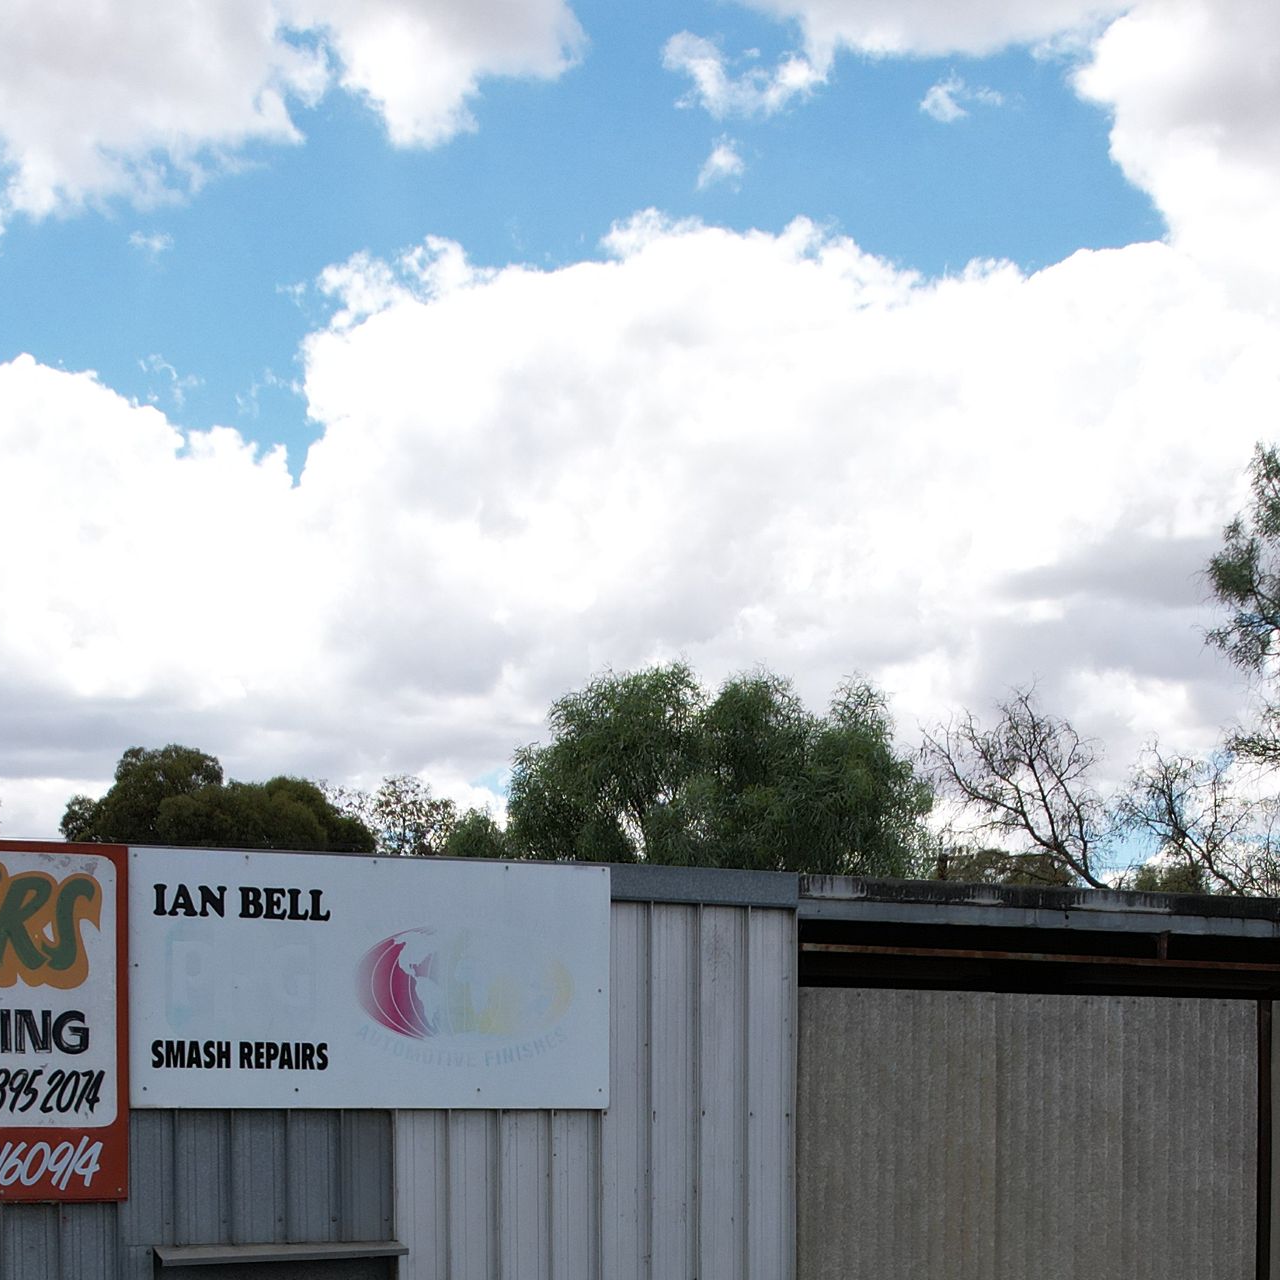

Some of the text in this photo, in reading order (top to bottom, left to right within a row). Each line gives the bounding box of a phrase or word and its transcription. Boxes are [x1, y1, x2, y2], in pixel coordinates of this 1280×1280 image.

[152, 883, 331, 921] IAN BELL
[151, 1039, 329, 1071] SMASH REPAIRS
